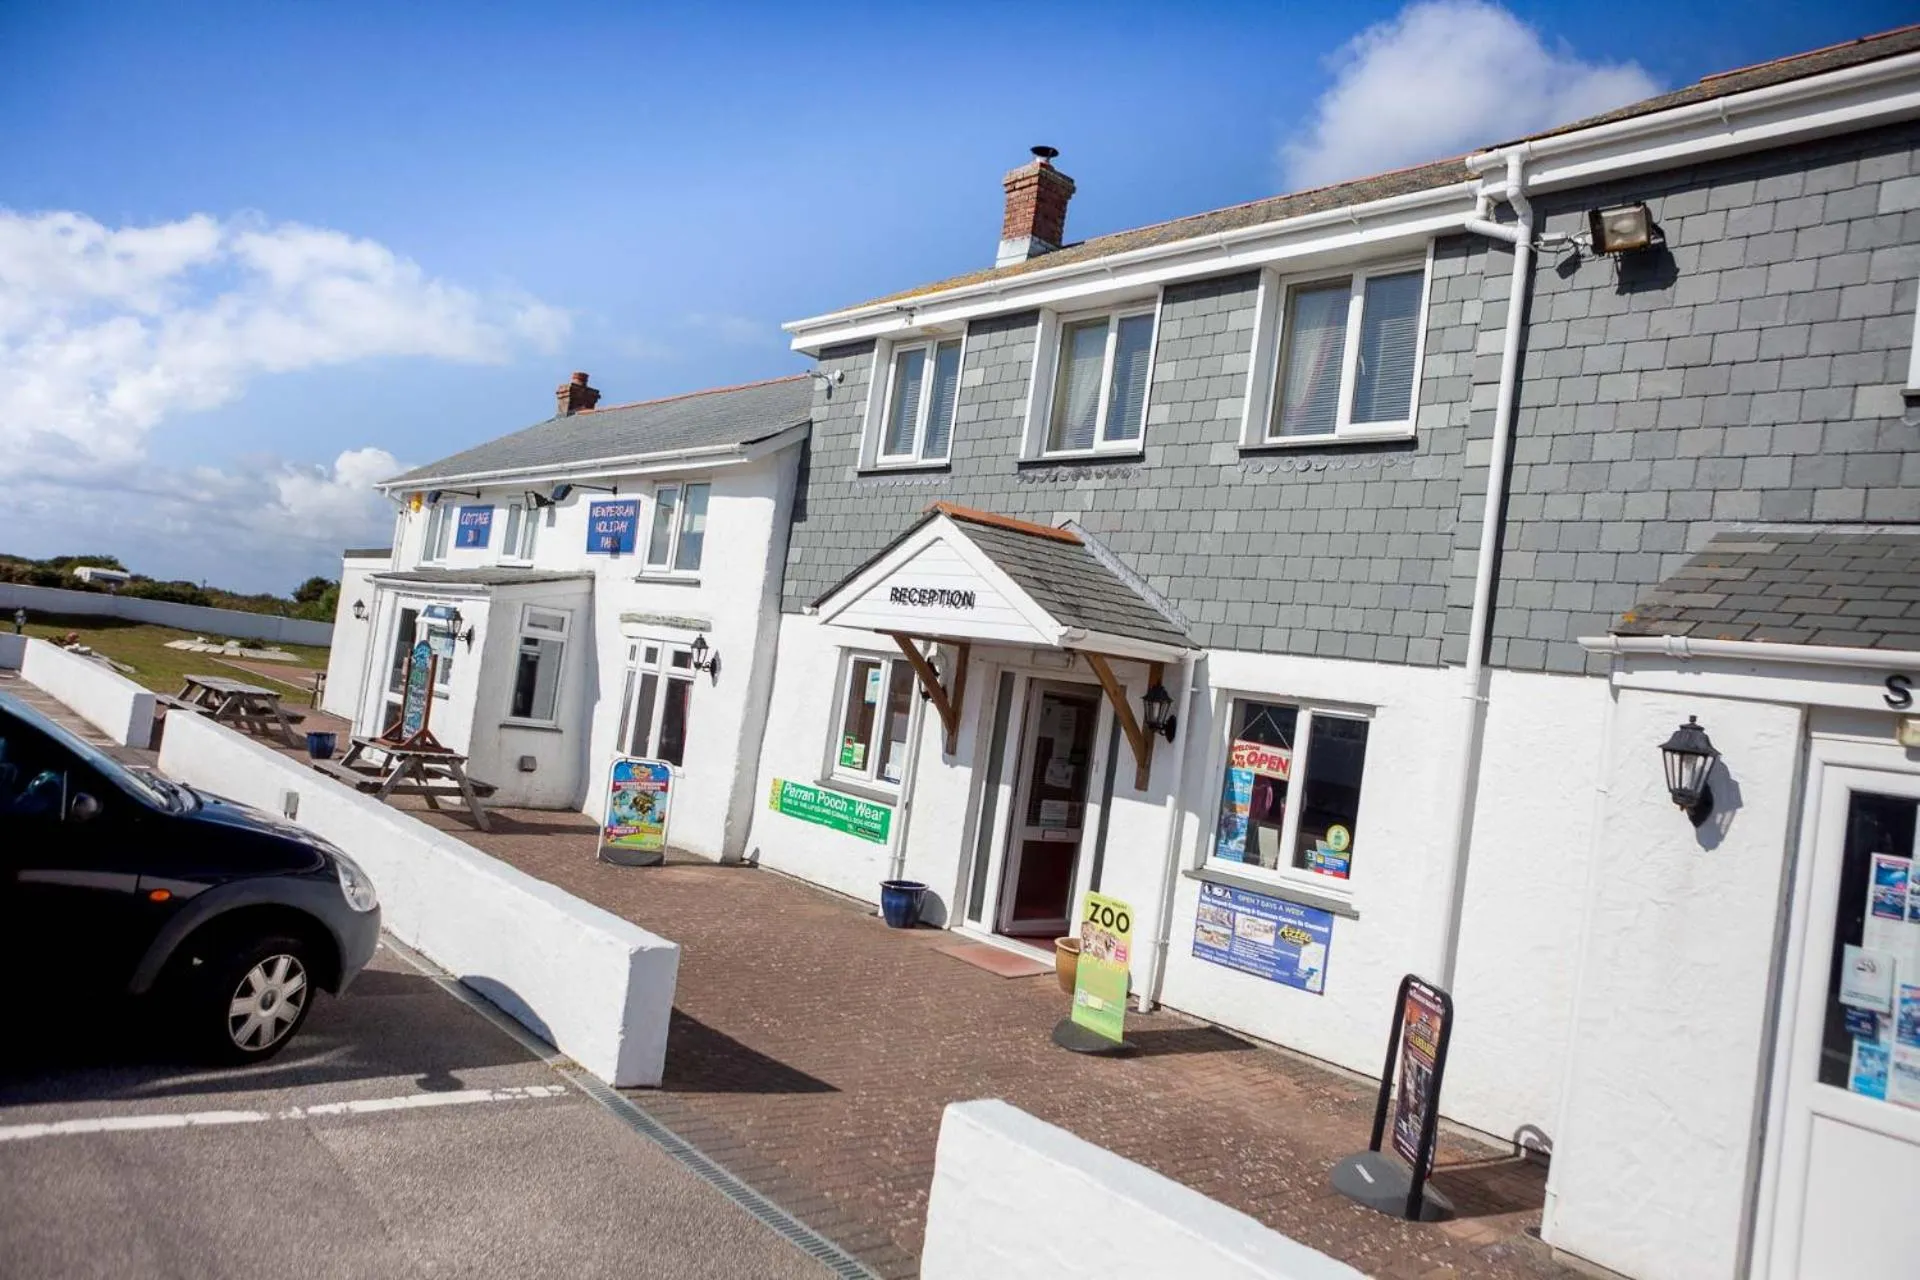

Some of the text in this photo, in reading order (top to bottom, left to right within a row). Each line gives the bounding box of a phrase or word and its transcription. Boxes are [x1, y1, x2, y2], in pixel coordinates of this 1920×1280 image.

[461, 511, 490, 525] COTTAGE
[596, 521, 628, 533] HOLIDAY
[890, 587, 976, 609] RECEPTION
[1247, 751, 1289, 774] OPEN
[783, 782, 815, 803] Perran
[817, 790, 848, 813] Pooch
[855, 800, 884, 820] Wear
[1238, 894, 1256, 905] OPEN
[1260, 900, 1278, 911] DAYS
[1285, 905, 1305, 916] WEEK
[1089, 902, 1130, 934] ZOO
